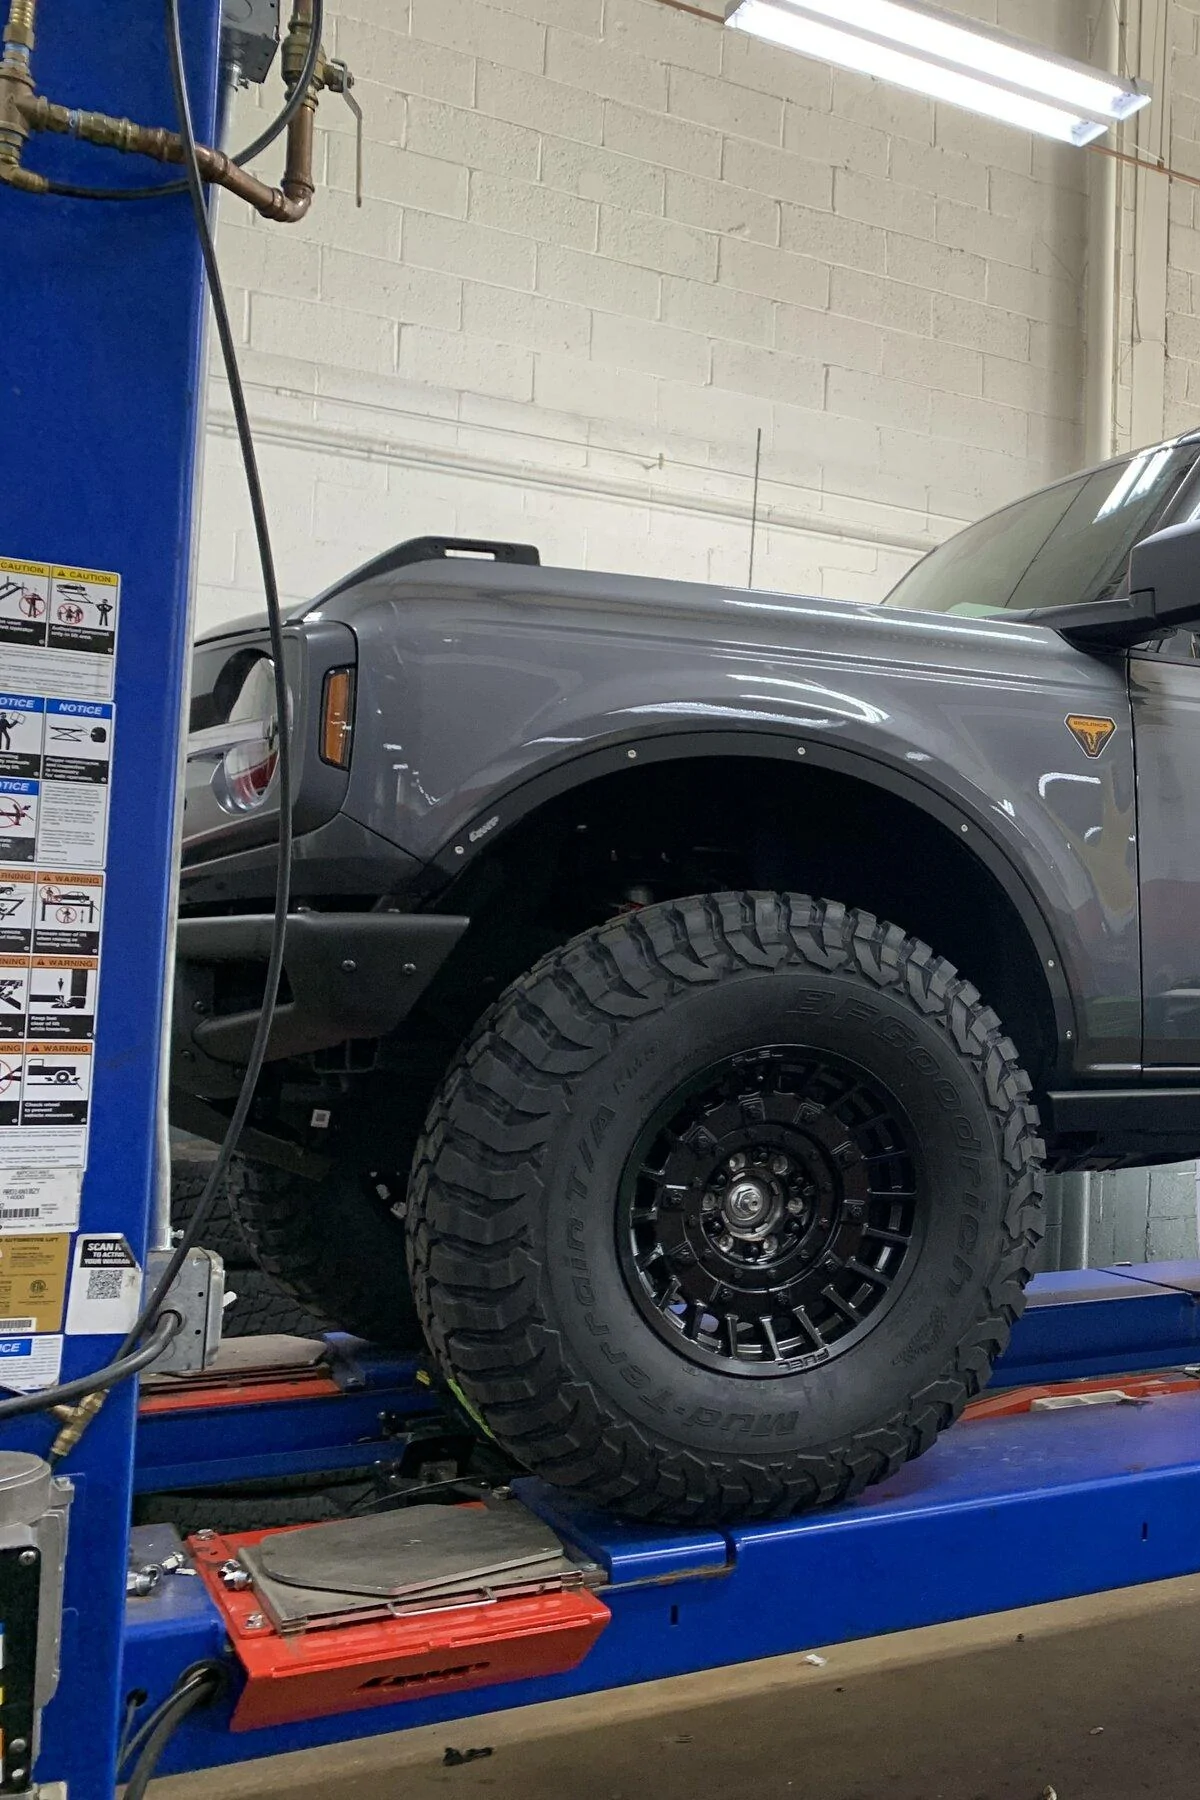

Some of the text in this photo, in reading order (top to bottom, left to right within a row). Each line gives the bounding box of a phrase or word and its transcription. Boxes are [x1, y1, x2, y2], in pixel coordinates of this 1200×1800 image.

[1, 562, 44, 574] CAUTION
[69, 571, 111, 583] CAUTION
[0, 697, 35, 709] OTICE
[59, 703, 102, 715] NOTICE
[0, 781, 30, 792] TICE
[55, 876, 99, 884] WARNING
[49, 959, 93, 968] WARNING
[44, 1045, 88, 1053] WARNING
[87, 1242, 114, 1252] SCAN
[777, 1347, 830, 1371] FUEL
